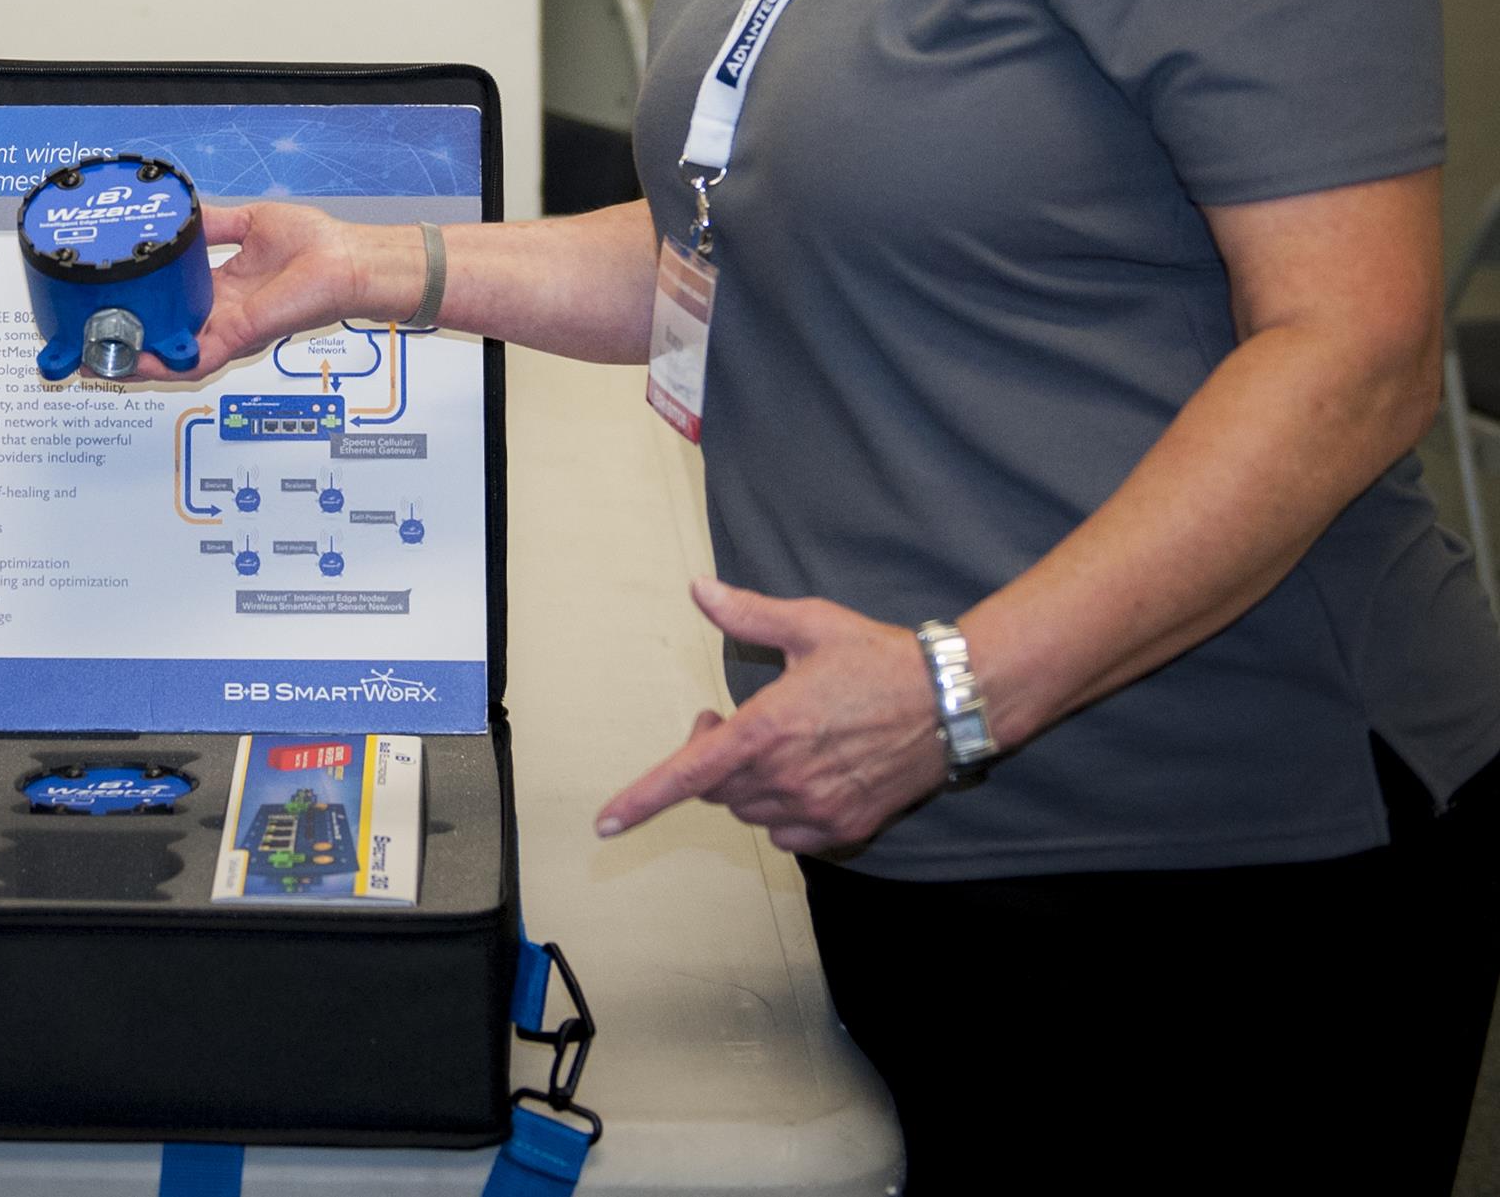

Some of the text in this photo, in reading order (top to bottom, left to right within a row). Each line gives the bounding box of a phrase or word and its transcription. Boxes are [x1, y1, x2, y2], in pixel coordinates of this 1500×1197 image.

[46, 200, 163, 222] Wzzard
[309, 337, 345, 346] Cellular
[307, 346, 347, 354] Network
[4, 381, 20, 392] to
[22, 383, 64, 392] assure
[15, 397, 40, 410] and
[123, 397, 141, 410] At
[143, 397, 165, 410] the
[3, 414, 58, 428] network
[61, 415, 91, 428] with
[93, 415, 153, 428] advanced
[0, 431, 27, 445] that
[29, 432, 72, 445] enable
[74, 432, 132, 449] powerful
[342, 437, 376, 447] Spectre
[339, 446, 417, 456] Ethernet Gateway
[53, 485, 77, 498] and
[21, 573, 46, 586] and
[48, 574, 129, 591] optimization
